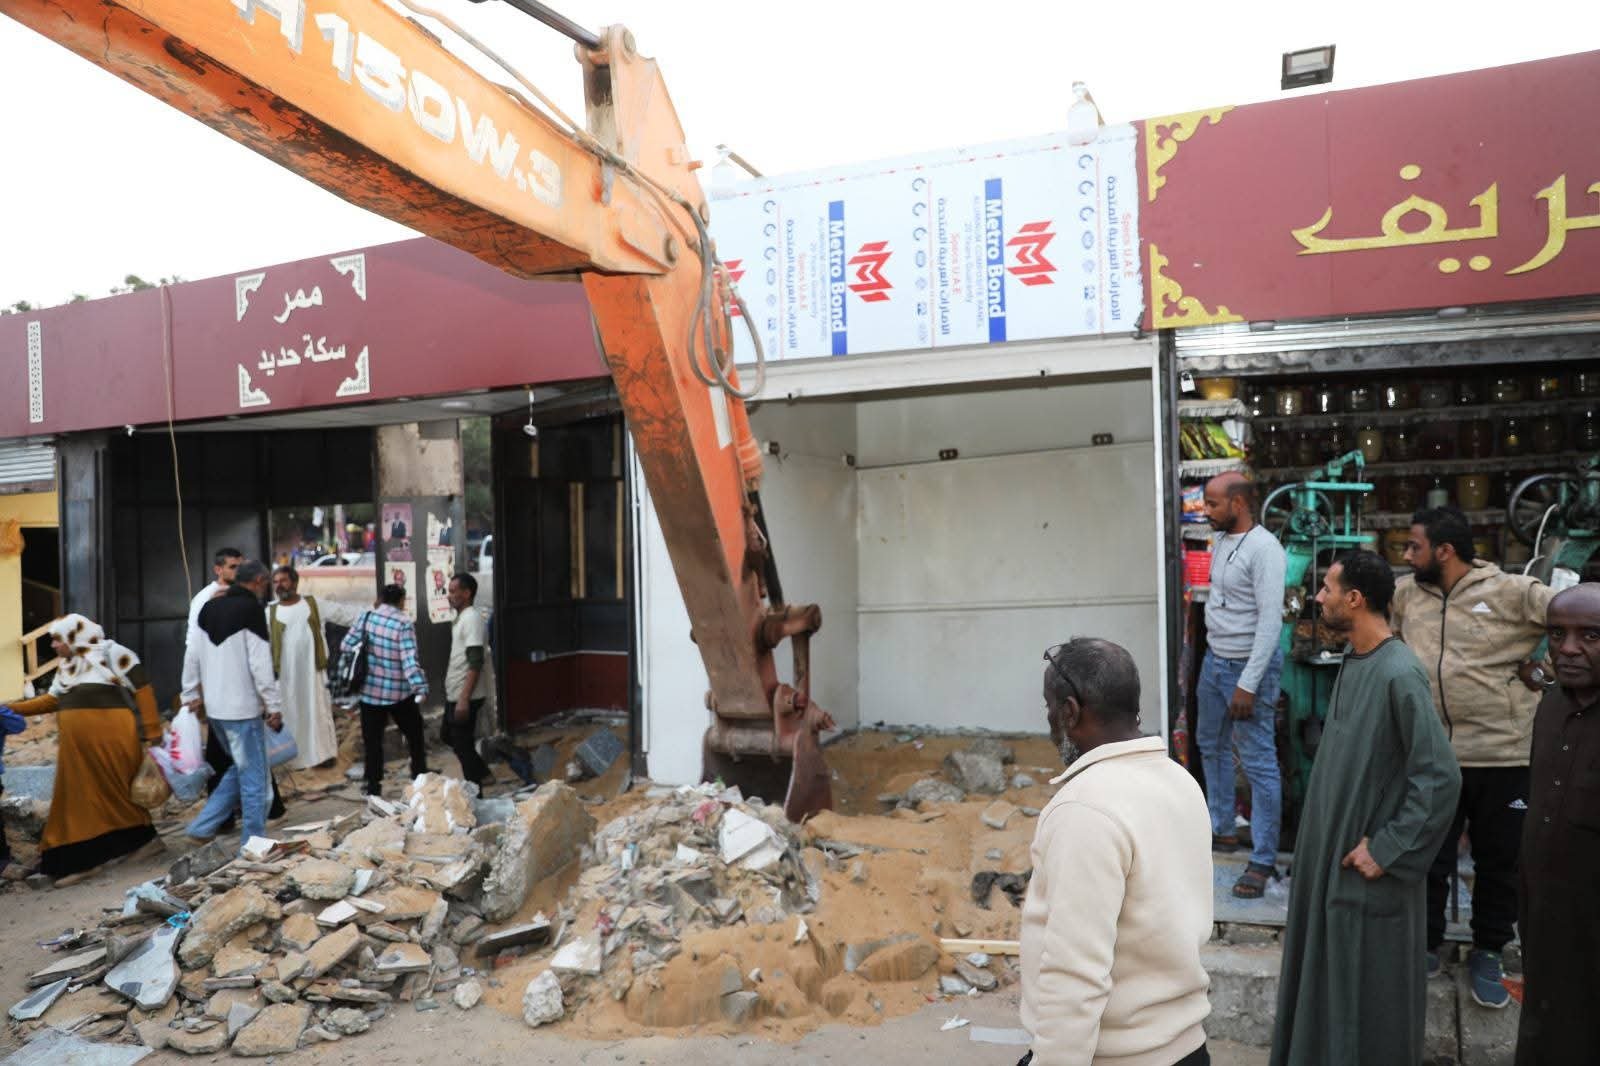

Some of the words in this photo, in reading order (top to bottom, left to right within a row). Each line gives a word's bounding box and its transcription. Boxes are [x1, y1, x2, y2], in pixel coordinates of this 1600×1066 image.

[985, 199, 1002, 259] Metro
[1291, 163, 1600, 275] ريف
[829, 220, 845, 278] Metro
[273, 285, 323, 324] ممر
[831, 281, 847, 333] Bond
[987, 263, 1006, 318] Bond
[257, 345, 302, 376] حديد
[302, 333, 347, 363] سكة
